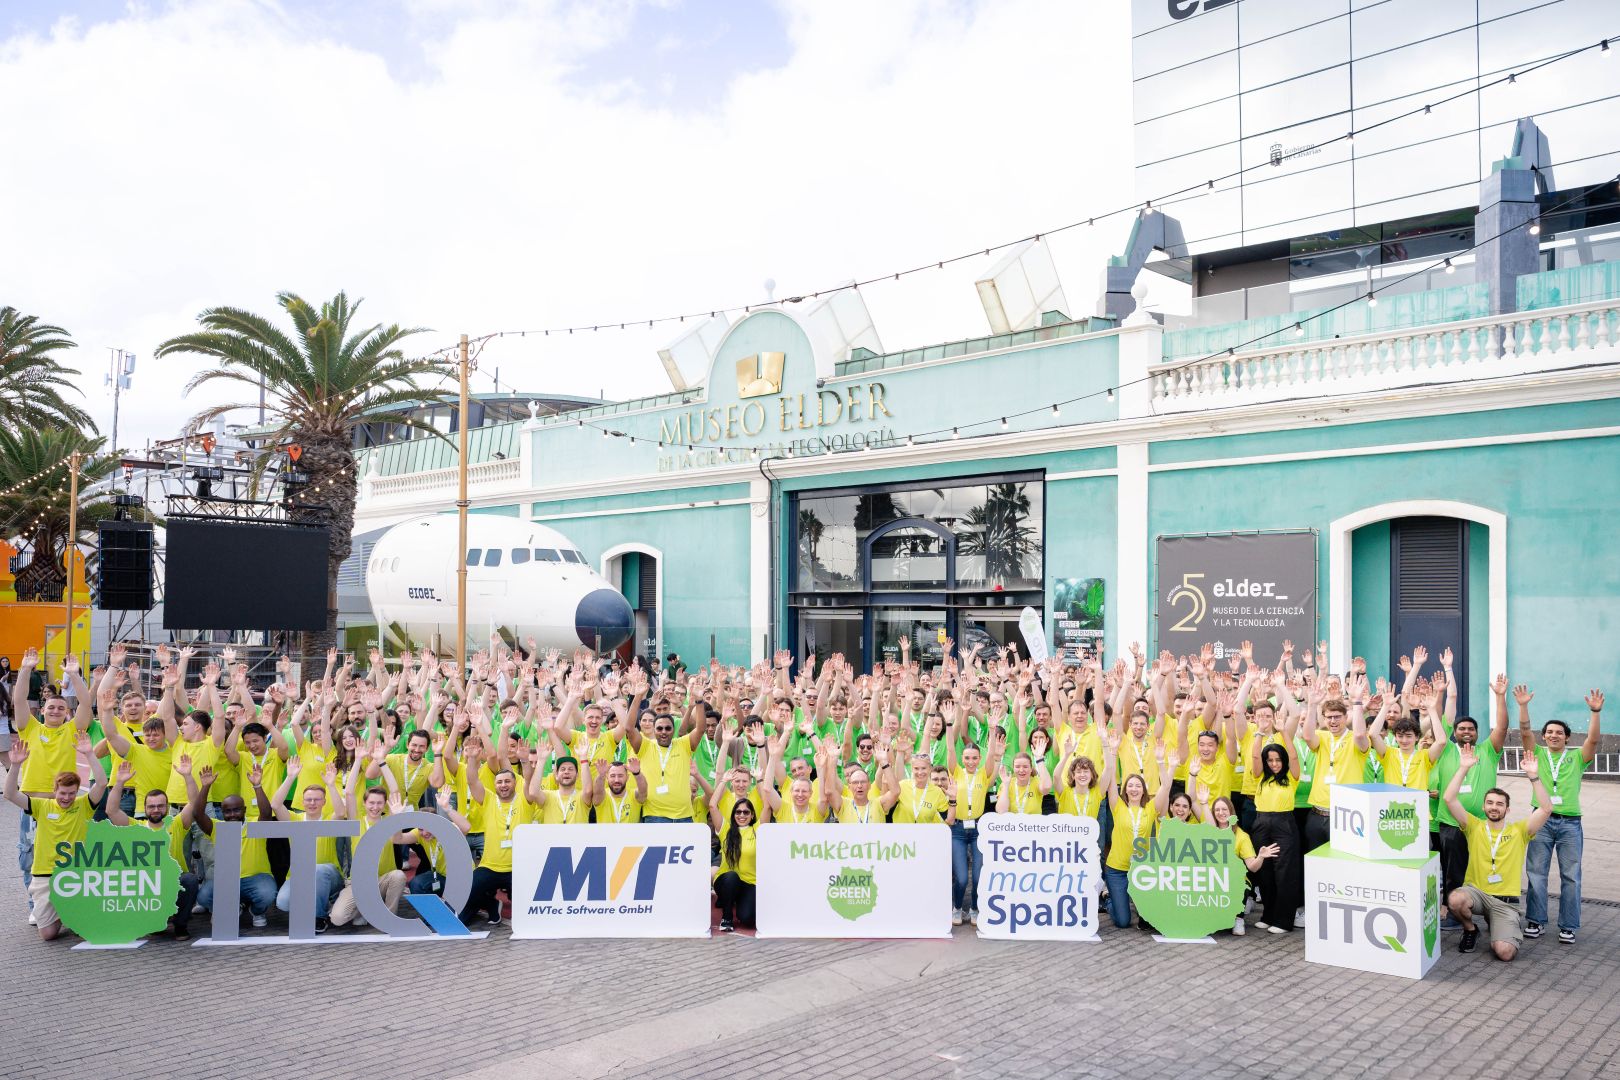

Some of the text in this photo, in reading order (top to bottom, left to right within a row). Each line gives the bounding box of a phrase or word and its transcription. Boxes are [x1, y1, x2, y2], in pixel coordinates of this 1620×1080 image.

[660, 382, 893, 446] MUSEO ELDER
[789, 425, 897, 457] TECNOLOGÍA
[1212, 606, 1305, 615] MUSEO DE LA CIENCIA
[1212, 617, 1286, 627] Y LA TECNOLOGÍA
[1334, 805, 1365, 838] ITQ
[1379, 808, 1415, 820] SMART
[1379, 819, 1414, 831] GREEN
[987, 822, 1090, 835] Gerda Stetter Stiftung
[54, 840, 166, 869] SMART
[988, 840, 1089, 864] Technik
[1132, 836, 1232, 864] SMART
[53, 869, 162, 898] GREEN
[212, 811, 474, 941] ITQ
[828, 874, 873, 887] SMART
[988, 864, 1088, 894] macht
[1131, 864, 1230, 893] GREEN
[102, 898, 162, 912] ISLAND
[827, 886, 872, 899] GREEN
[1176, 893, 1231, 908] ISLAND
[527, 904, 653, 916] MVTec Software GmbH
[987, 894, 1089, 934] Spaß!
[1318, 900, 1408, 953] ITQ
